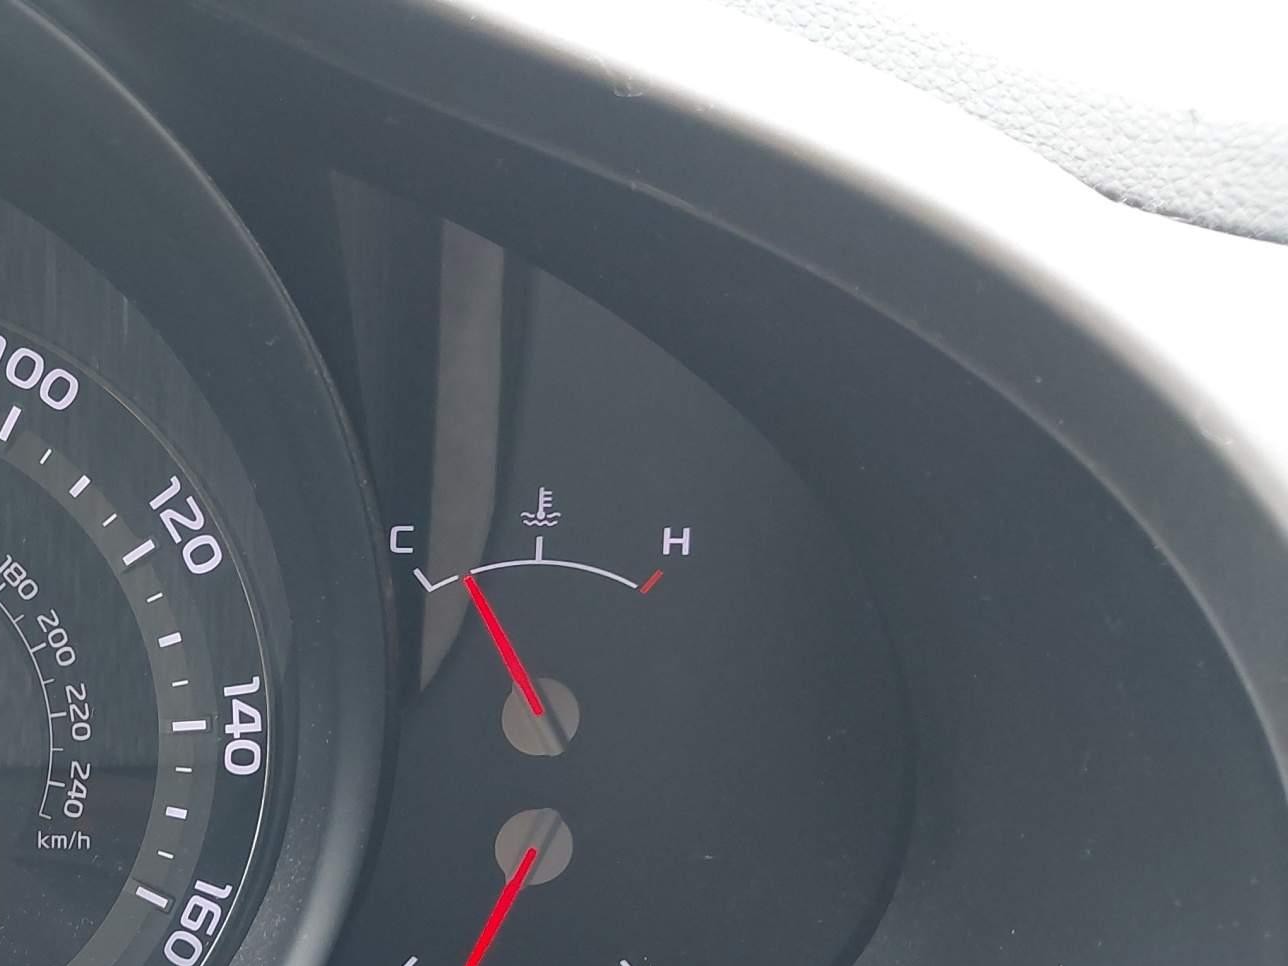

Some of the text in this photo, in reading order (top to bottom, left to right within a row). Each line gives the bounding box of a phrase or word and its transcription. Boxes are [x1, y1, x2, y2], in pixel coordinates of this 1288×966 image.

[149, 475, 222, 575] 120
[389, 525, 414, 553] C
[662, 527, 691, 556] H
[36, 609, 77, 667] 200
[65, 682, 92, 742] 220
[223, 676, 263, 775] 140
[63, 760, 91, 819] 240
[36, 831, 91, 851] km/h
